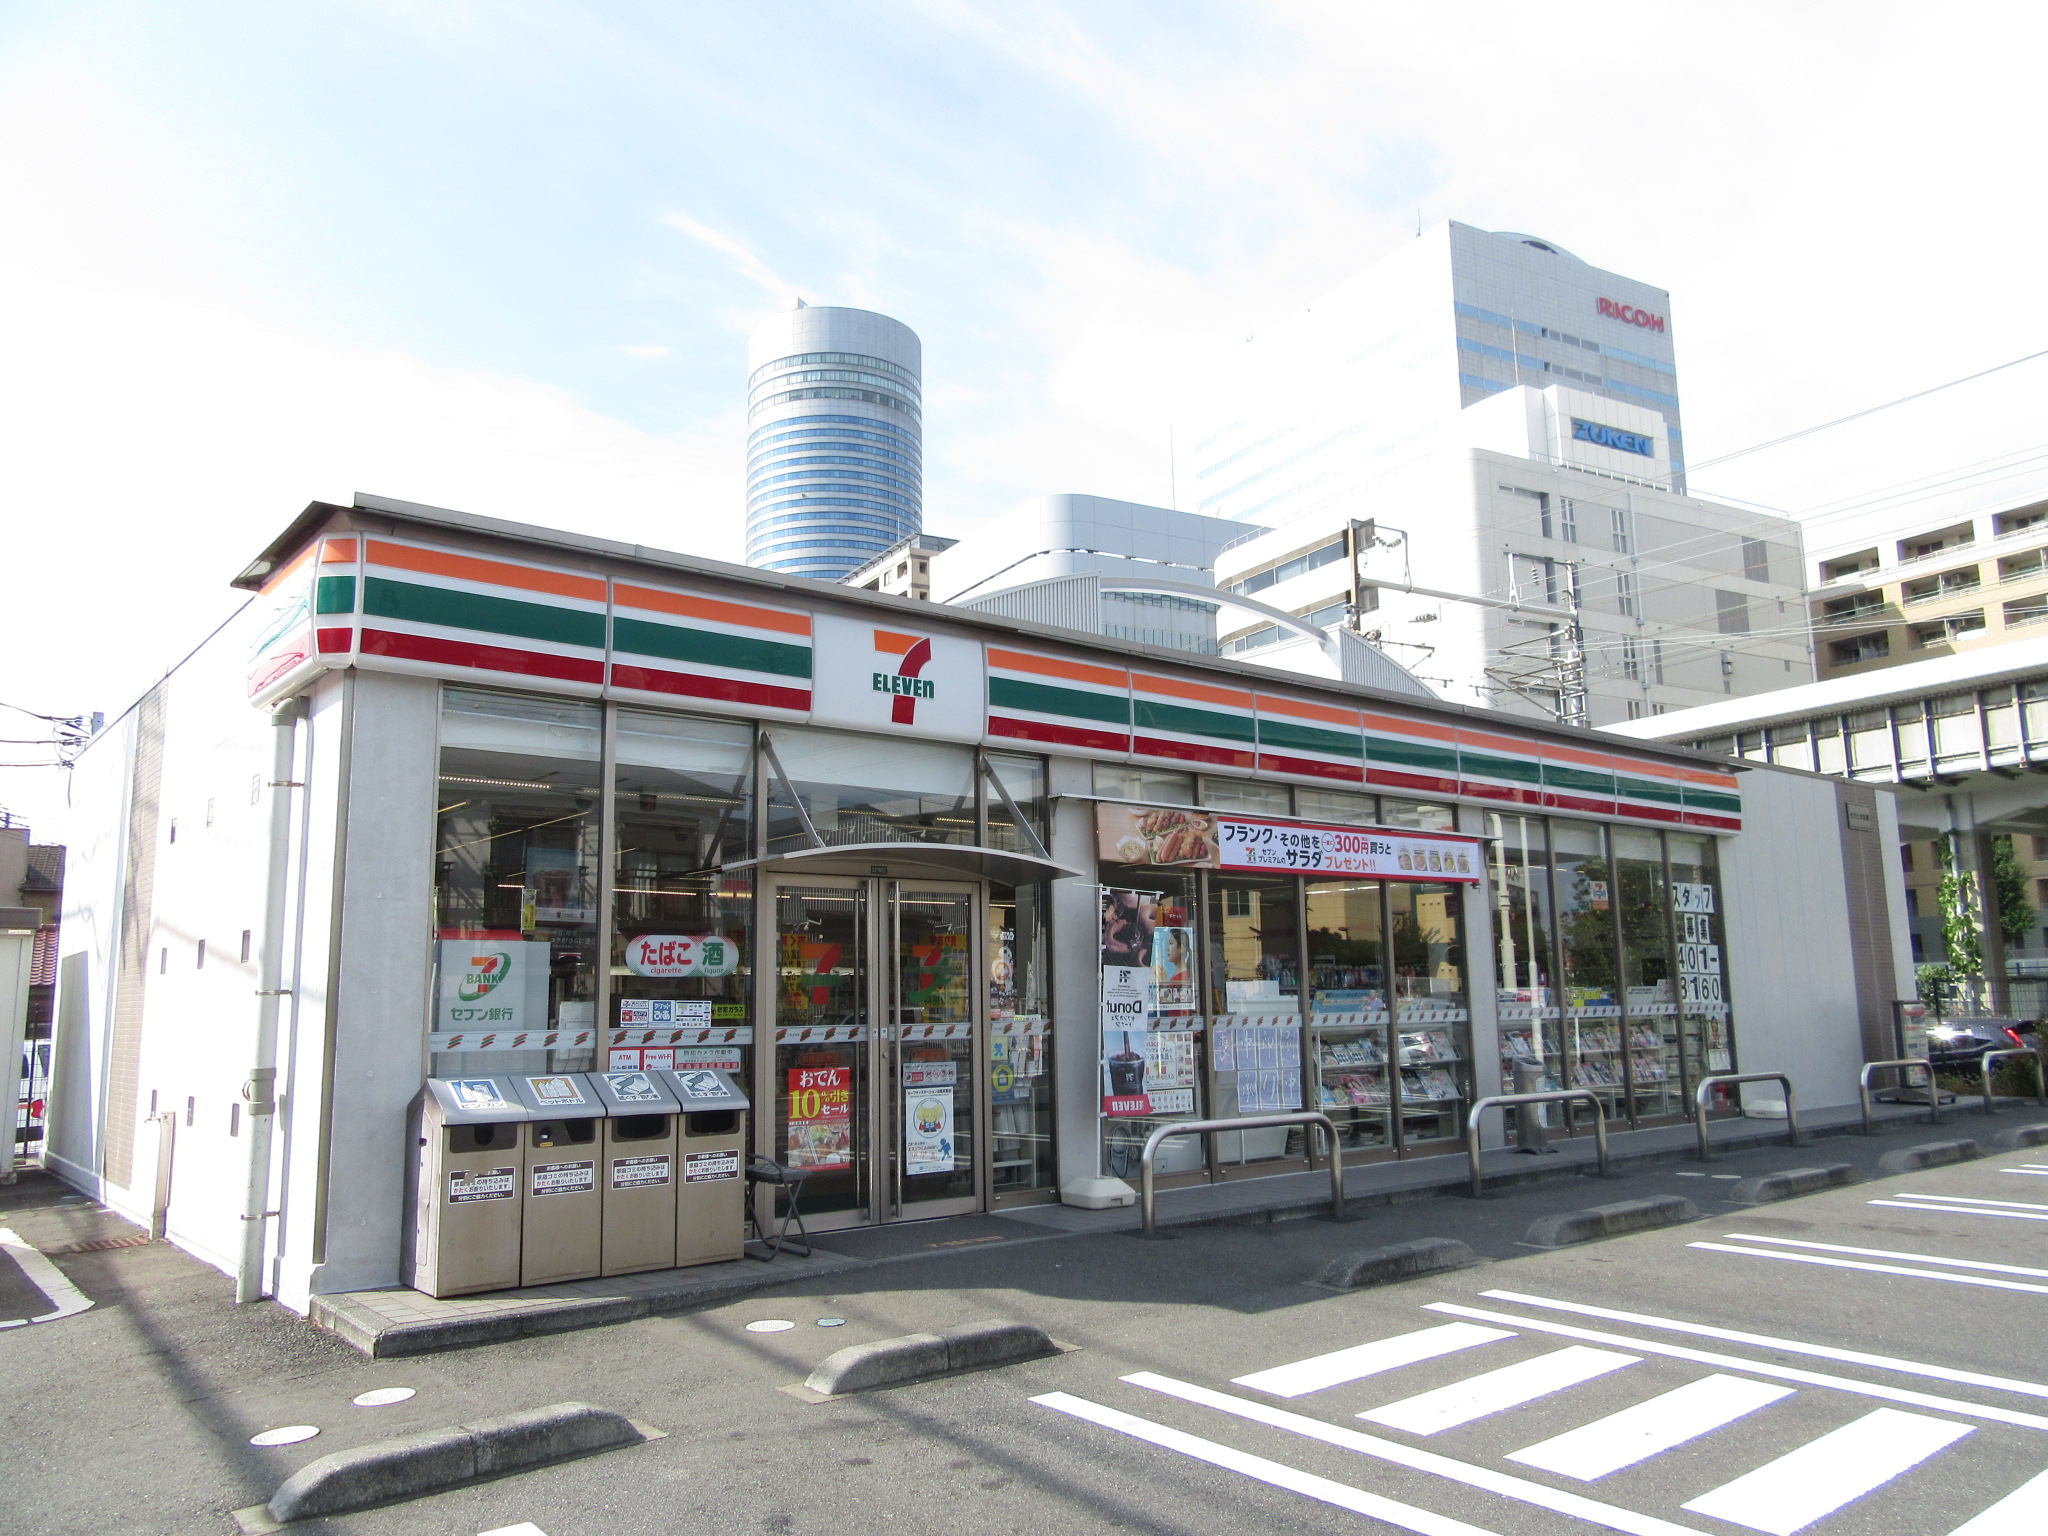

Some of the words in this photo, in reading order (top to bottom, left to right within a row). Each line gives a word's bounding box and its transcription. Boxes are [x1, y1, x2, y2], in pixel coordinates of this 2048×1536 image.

[1597, 297, 1665, 333] RICOH
[1572, 421, 1654, 457] ZUKEN
[873, 629, 932, 726] 7
[1286, 849, 1323, 868] サラダ
[640, 941, 693, 966] たばこ
[702, 942, 724, 966] 酒
[466, 973, 500, 984] BANK
[450, 1007, 514, 1021] セブン銀行
[799, 1069, 841, 1088] おでん
[821, 1104, 849, 1115] セール
